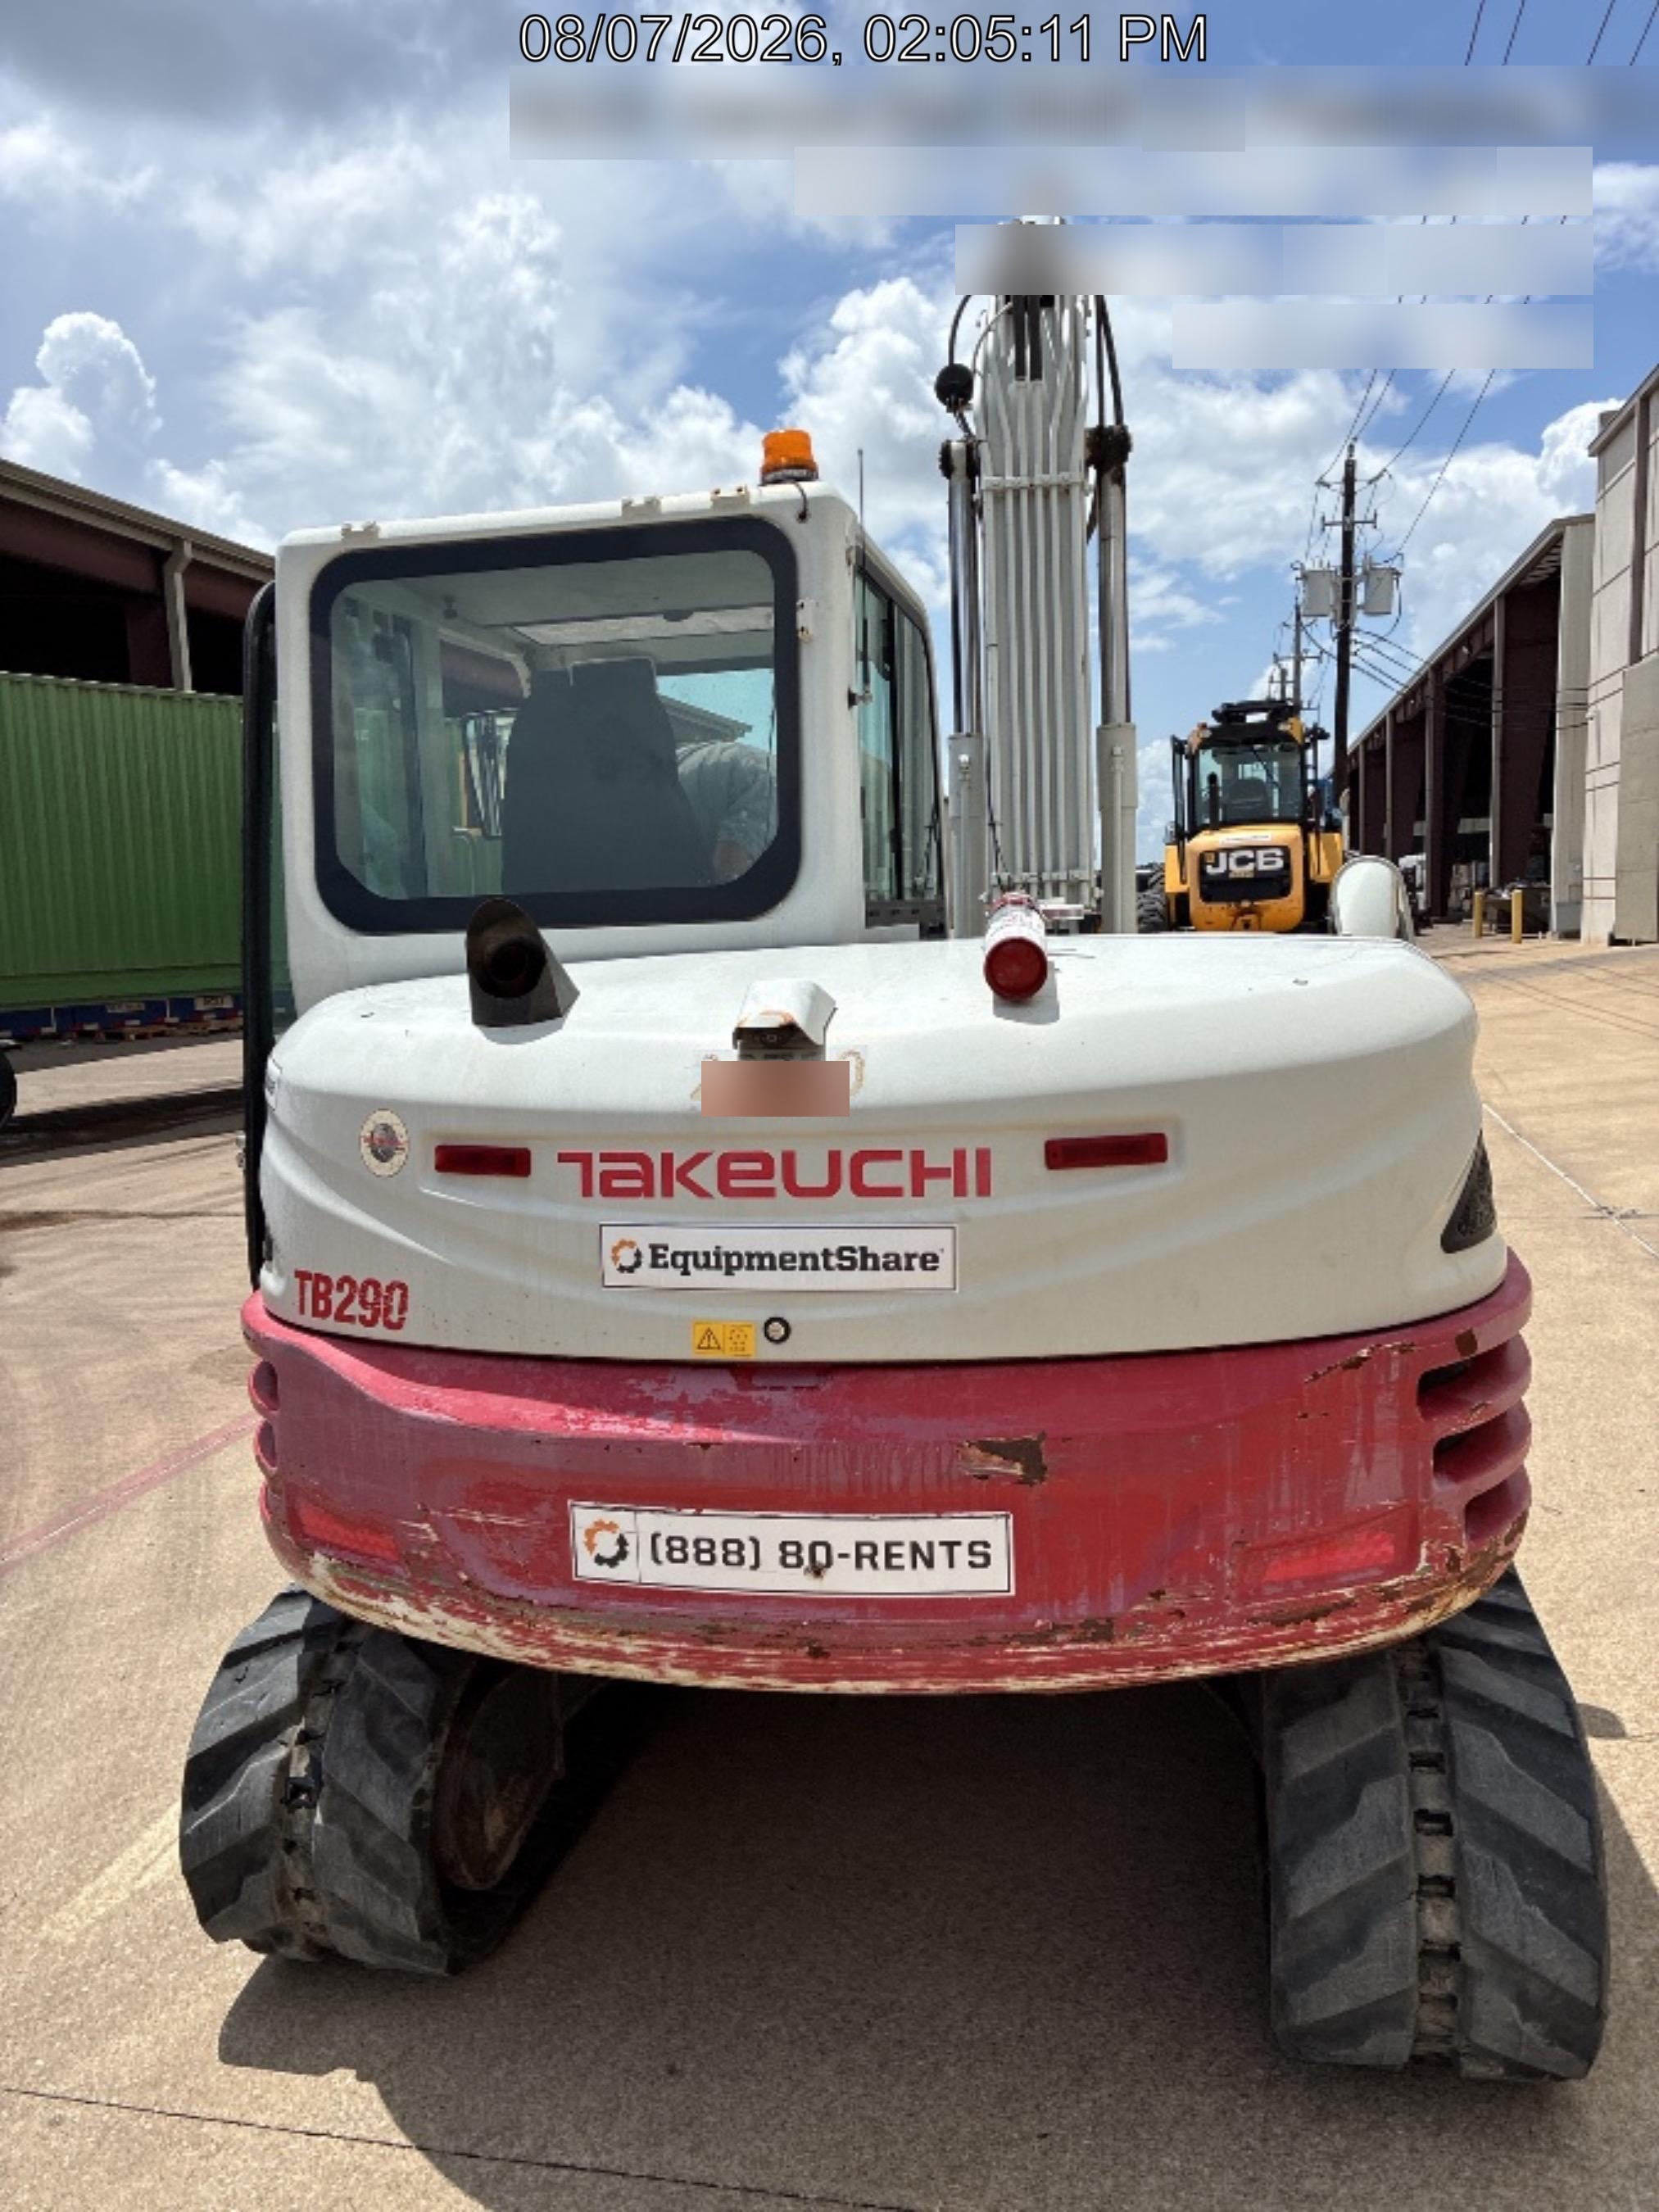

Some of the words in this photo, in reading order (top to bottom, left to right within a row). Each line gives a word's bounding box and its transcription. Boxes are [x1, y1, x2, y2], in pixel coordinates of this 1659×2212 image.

[1206, 848, 1284, 875] JCB
[557, 1148, 991, 1199] TAKEUCHI
[649, 1243, 940, 1276] EquipmentShare
[294, 1270, 409, 1330] TB290
[650, 1533, 762, 1571] (888)
[779, 1539, 992, 1571] 80-RENTS
